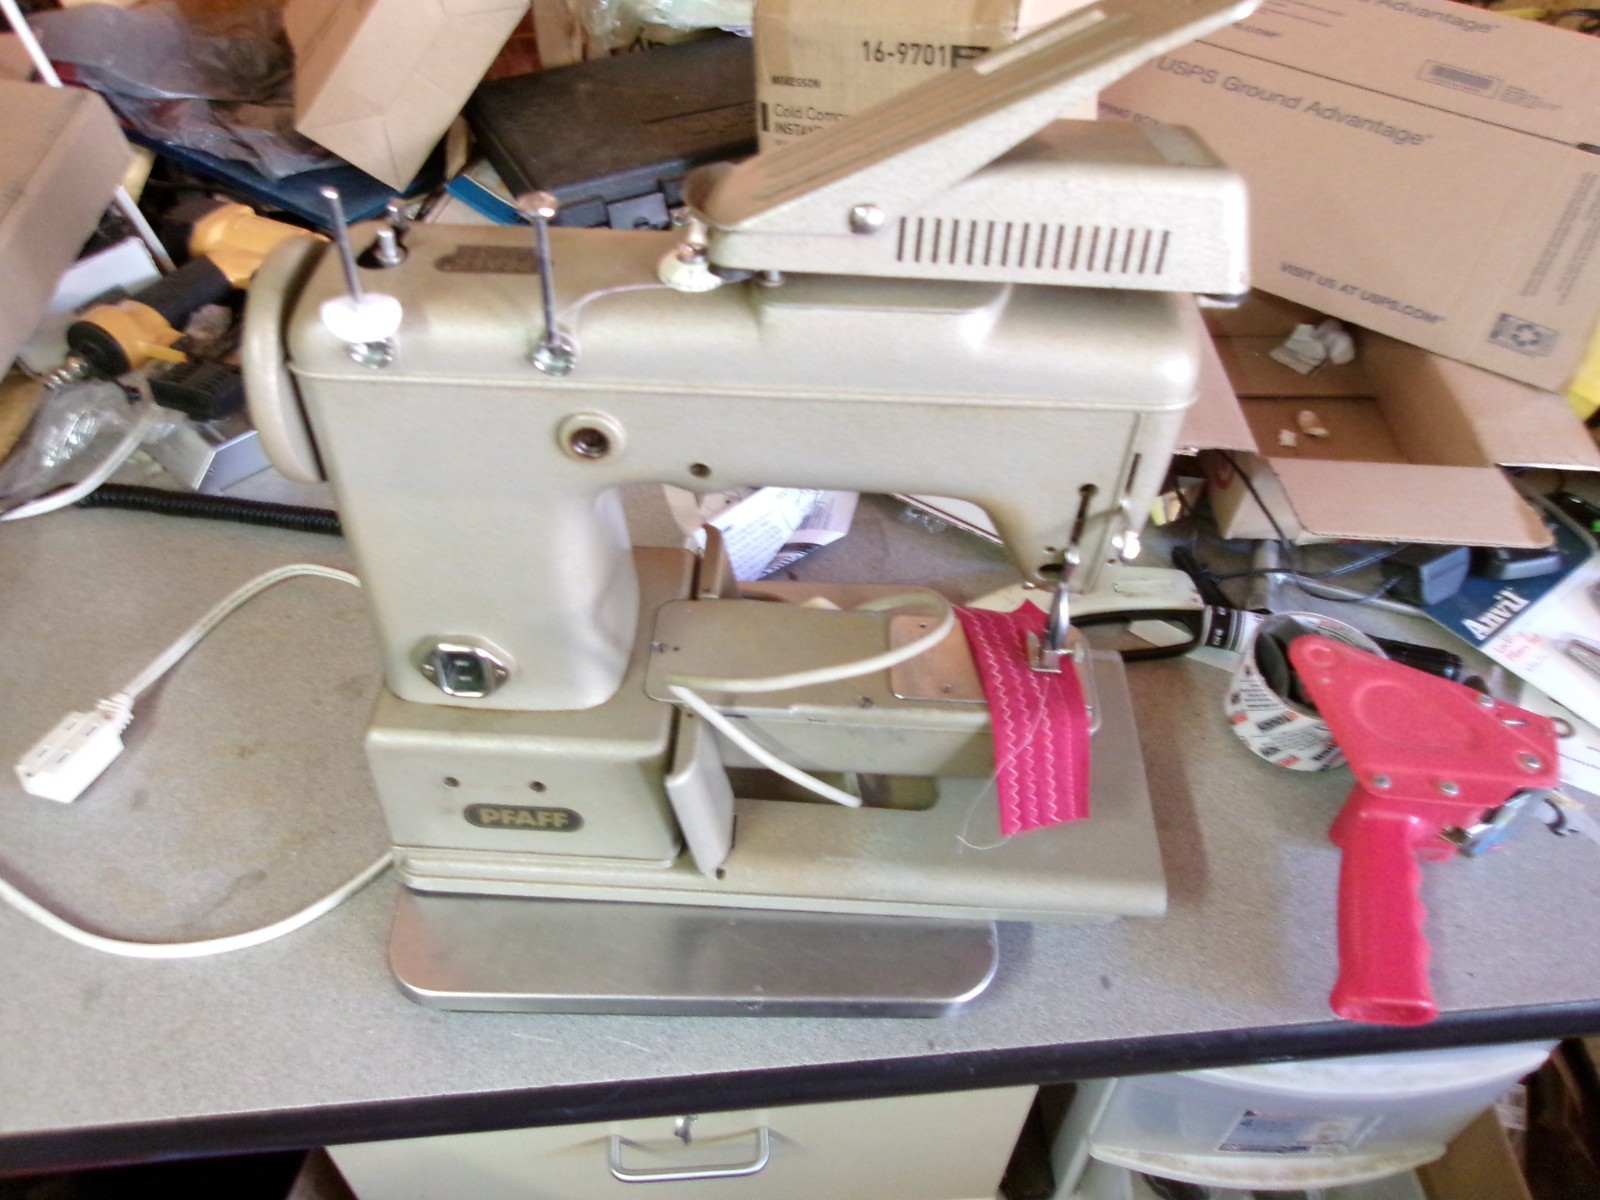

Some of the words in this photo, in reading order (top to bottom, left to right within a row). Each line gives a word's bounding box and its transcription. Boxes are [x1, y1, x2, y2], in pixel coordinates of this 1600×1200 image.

[863, 40, 946, 66] 16-9701
[1157, 57, 1219, 85] USPS
[1223, 76, 1303, 109] Ground
[1304, 101, 1423, 146] Advantage
[1461, 586, 1531, 641] Anvil
[480, 807, 569, 828] PFAFF
